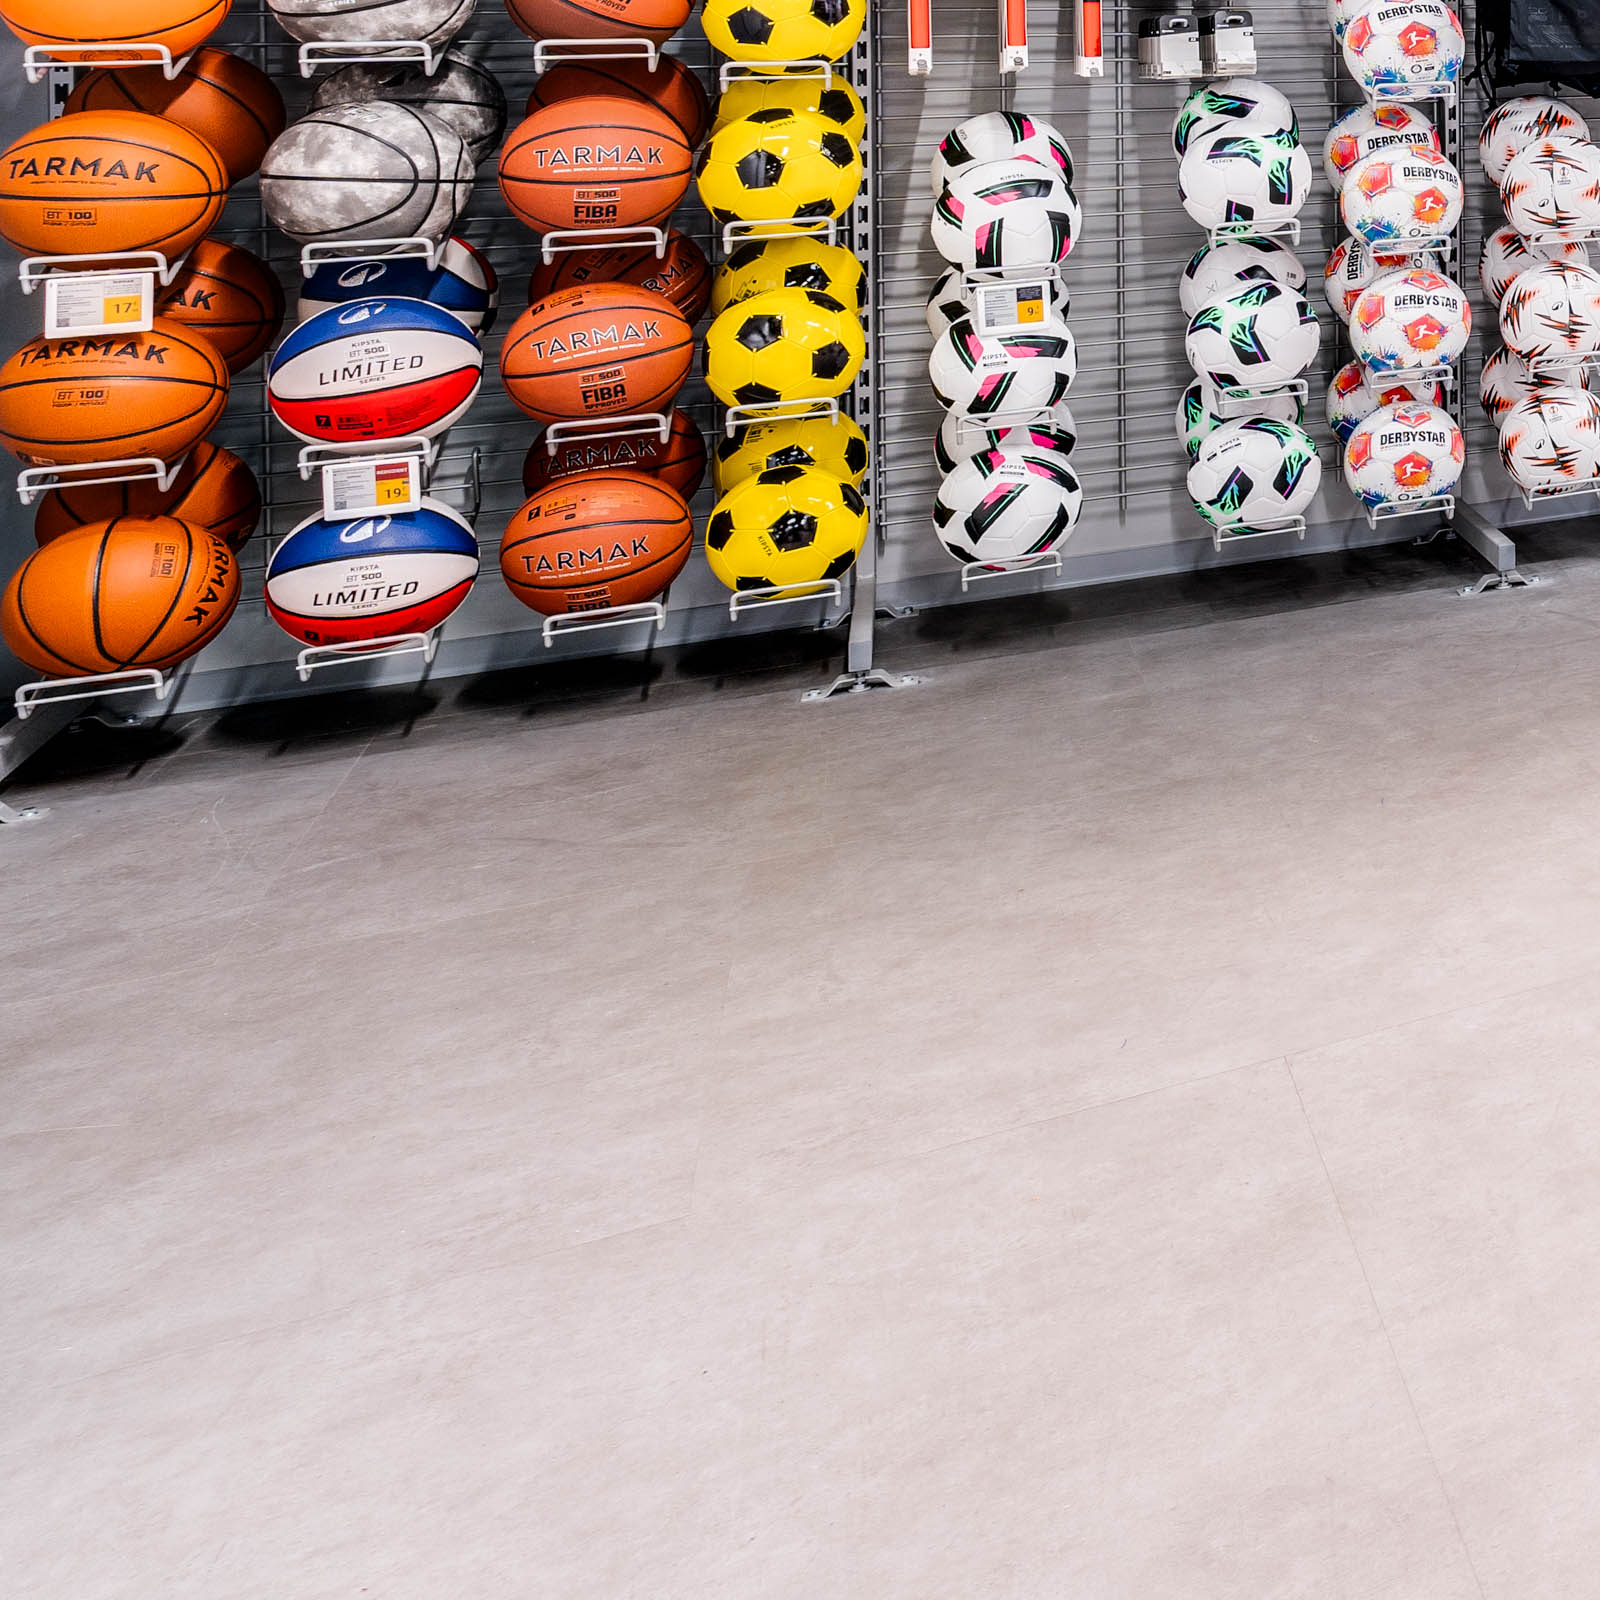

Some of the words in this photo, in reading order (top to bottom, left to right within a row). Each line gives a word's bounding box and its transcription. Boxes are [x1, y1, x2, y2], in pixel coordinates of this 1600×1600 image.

[1377, 4, 1441, 22] DERBYSTAR
[1367, 132, 1429, 151] DERBYSTAR
[534, 145, 664, 169] TARMAK
[9, 156, 160, 183] TARMAK
[1402, 166, 1459, 187] DERBYSTAR
[578, 191, 590, 200] BT
[594, 189, 617, 198] 500
[46, 210, 62, 220] BT
[68, 211, 92, 219] 100
[573, 204, 618, 219] FIBA
[114, 302, 131, 314] 17
[1394, 294, 1458, 311] DERBYSTAR
[352, 339, 381, 348] KIPSTA
[531, 320, 663, 360] TARMAK
[20, 340, 169, 368] TARMAK
[364, 346, 385, 355] 500
[981, 353, 1008, 361] KIPSTA
[319, 355, 425, 386] LIMITED
[582, 373, 596, 383] BT
[598, 369, 621, 380] 500
[56, 391, 73, 400] BT
[79, 389, 104, 399] 100
[581, 384, 627, 404] FIBA
[1380, 430, 1446, 446] DERBYSTAR
[385, 488, 402, 499] 19
[756, 534, 773, 557] KIPSTA
[521, 535, 651, 574] TARMAK
[160, 557, 173, 576] 100
[350, 564, 379, 572] KIPSTA
[361, 572, 382, 580] 500
[313, 581, 419, 607] LIMITED
